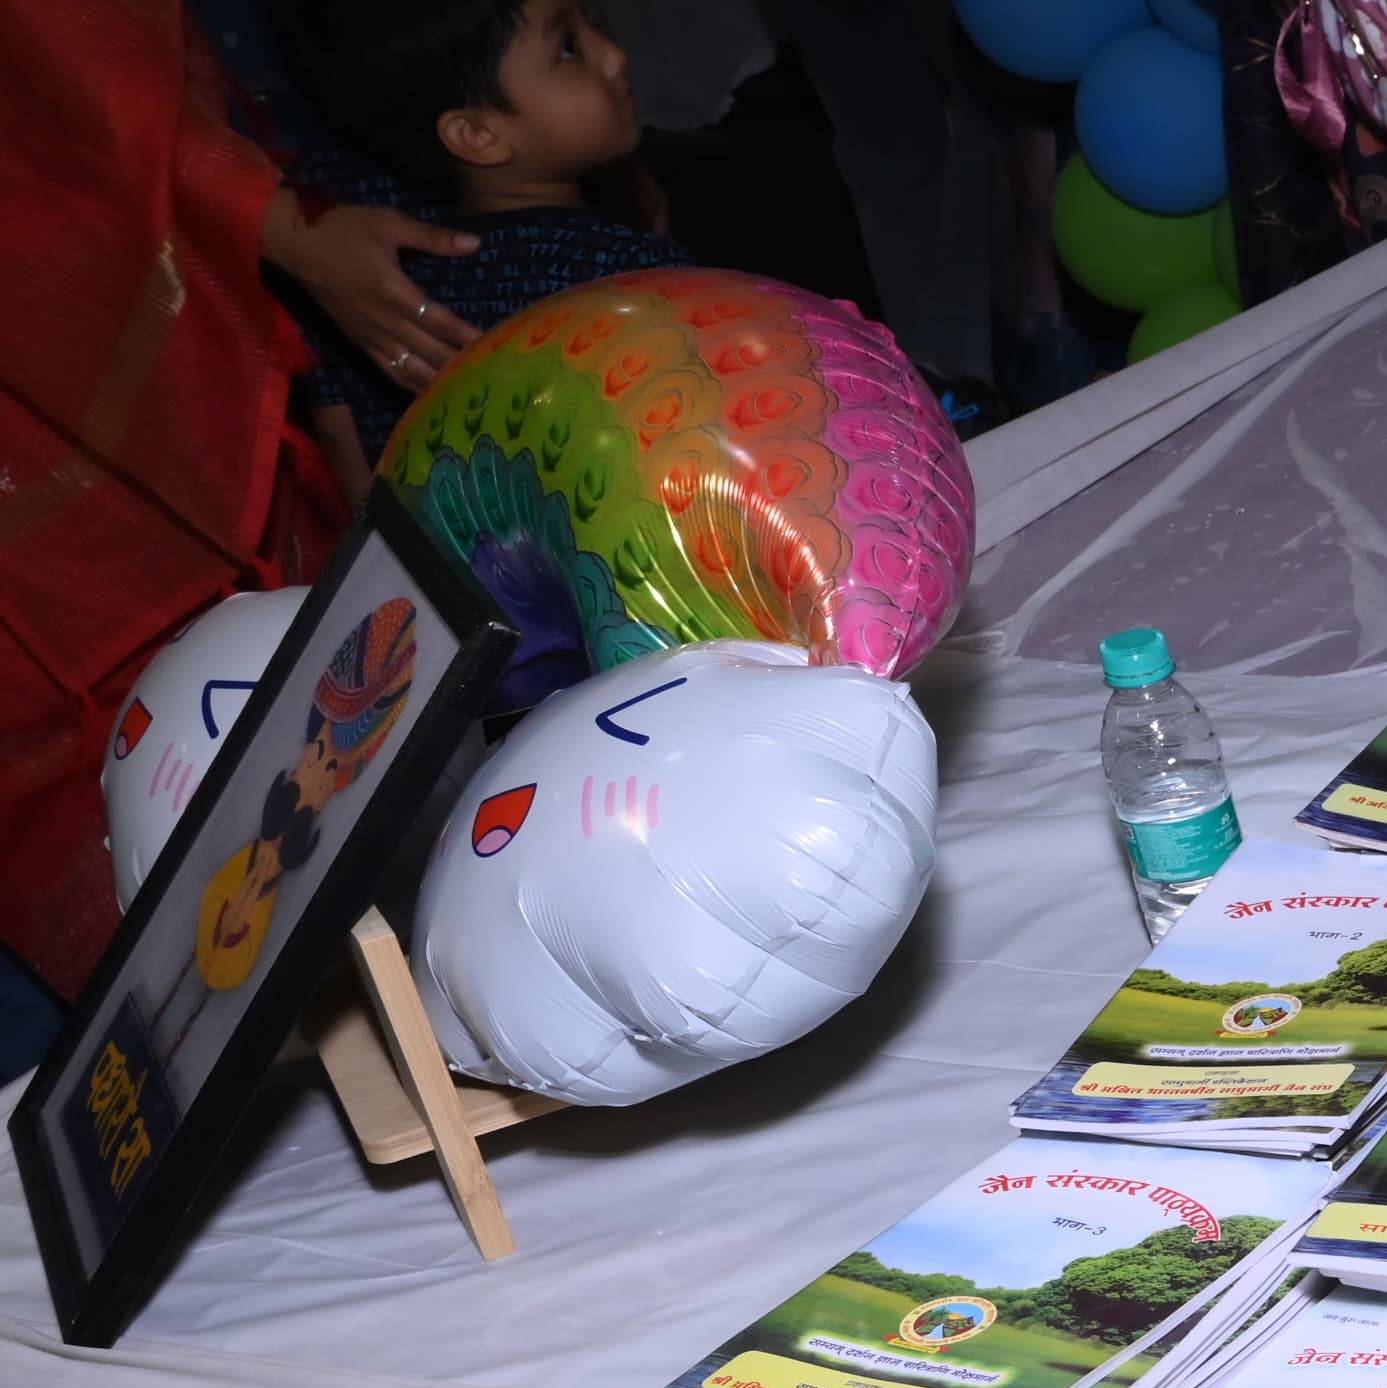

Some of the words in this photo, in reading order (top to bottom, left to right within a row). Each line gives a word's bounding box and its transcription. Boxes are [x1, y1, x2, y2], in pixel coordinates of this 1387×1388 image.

[1224, 900, 1272, 919] जैन
[1281, 892, 1380, 909] संस्कार
[1308, 930, 1362, 941] भाग-2
[978, 1175, 1037, 1194] जैन
[1046, 1169, 1150, 1196] संस्कार
[1149, 1186, 1221, 1243] पाठ्यक्रम
[1052, 1217, 1107, 1236] भाग-3
[1287, 1348, 1342, 1366] जैन
